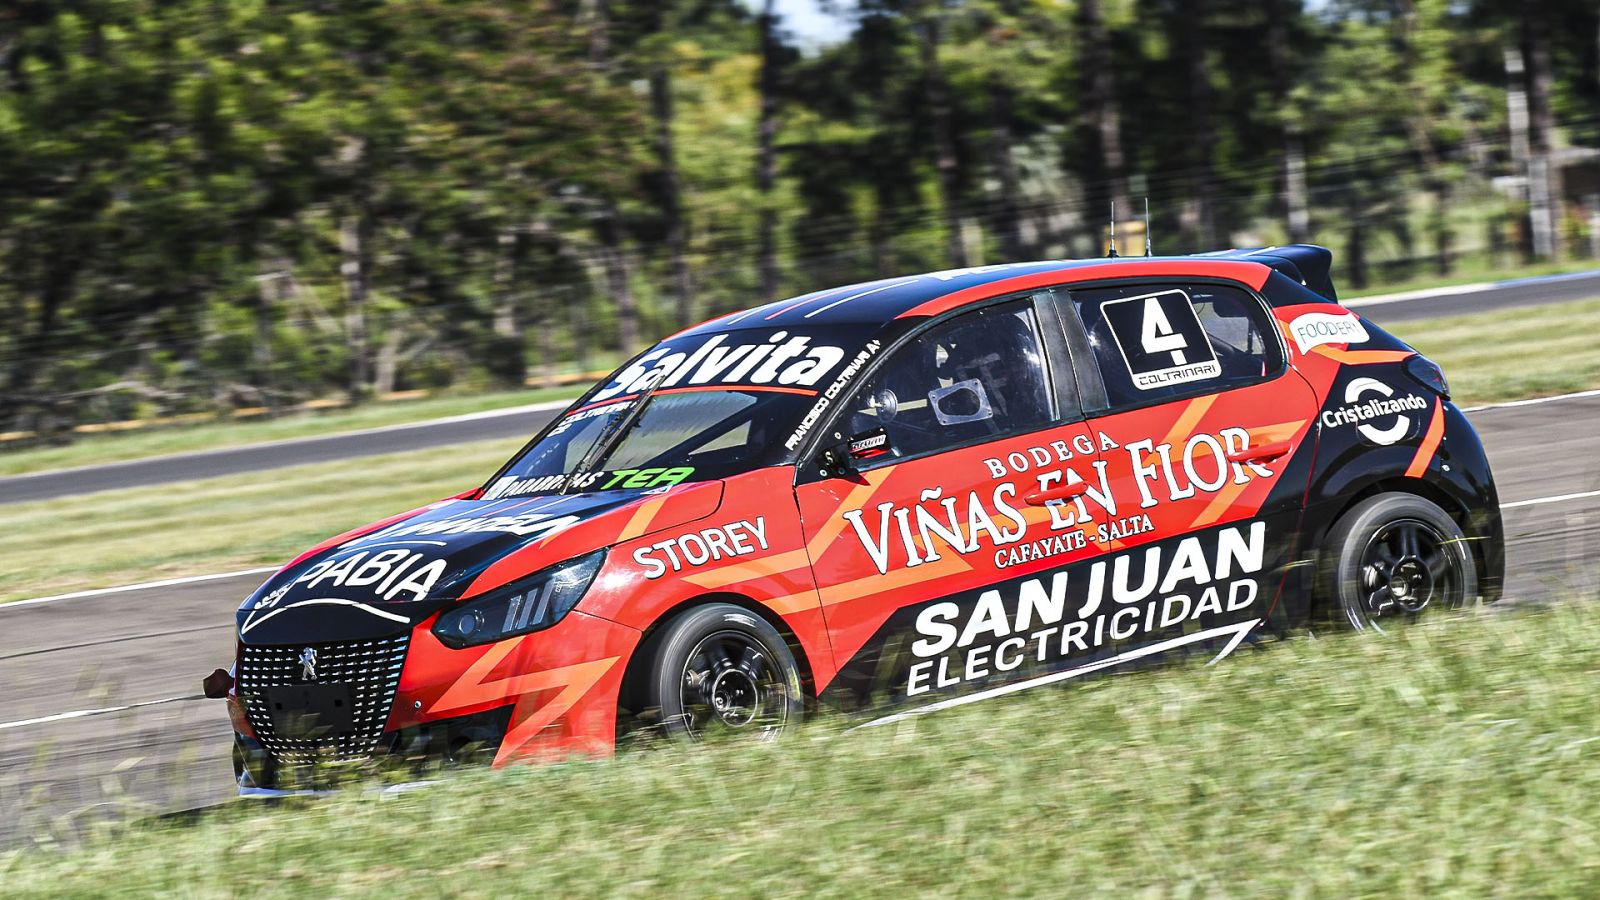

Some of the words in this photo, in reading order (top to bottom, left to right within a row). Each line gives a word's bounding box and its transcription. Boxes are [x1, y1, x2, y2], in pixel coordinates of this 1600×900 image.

[1141, 297, 1187, 365] 4
[590, 331, 844, 402] Salvita
[1138, 364, 1216, 386] COLTRINARI
[785, 397, 830, 451] FRANCISCO
[825, 351, 871, 400] COLTRINARI
[1322, 392, 1427, 428] Cristalizando
[600, 466, 696, 490] TEA
[983, 430, 1120, 479] BODEGA
[497, 471, 605, 499] PARABRAS
[843, 481, 1028, 575] VIÑAS
[1036, 460, 1118, 531] EN
[1125, 427, 1274, 510] FLOR
[633, 516, 769, 580] STOREY
[994, 529, 1087, 569] CAFAYATE
[1098, 513, 1155, 543] SALTA
[297, 549, 447, 602] PABIA
[911, 571, 1069, 658] SAN
[1078, 521, 1266, 620] JUAN
[906, 578, 1258, 697] ELECTRICIDAD
